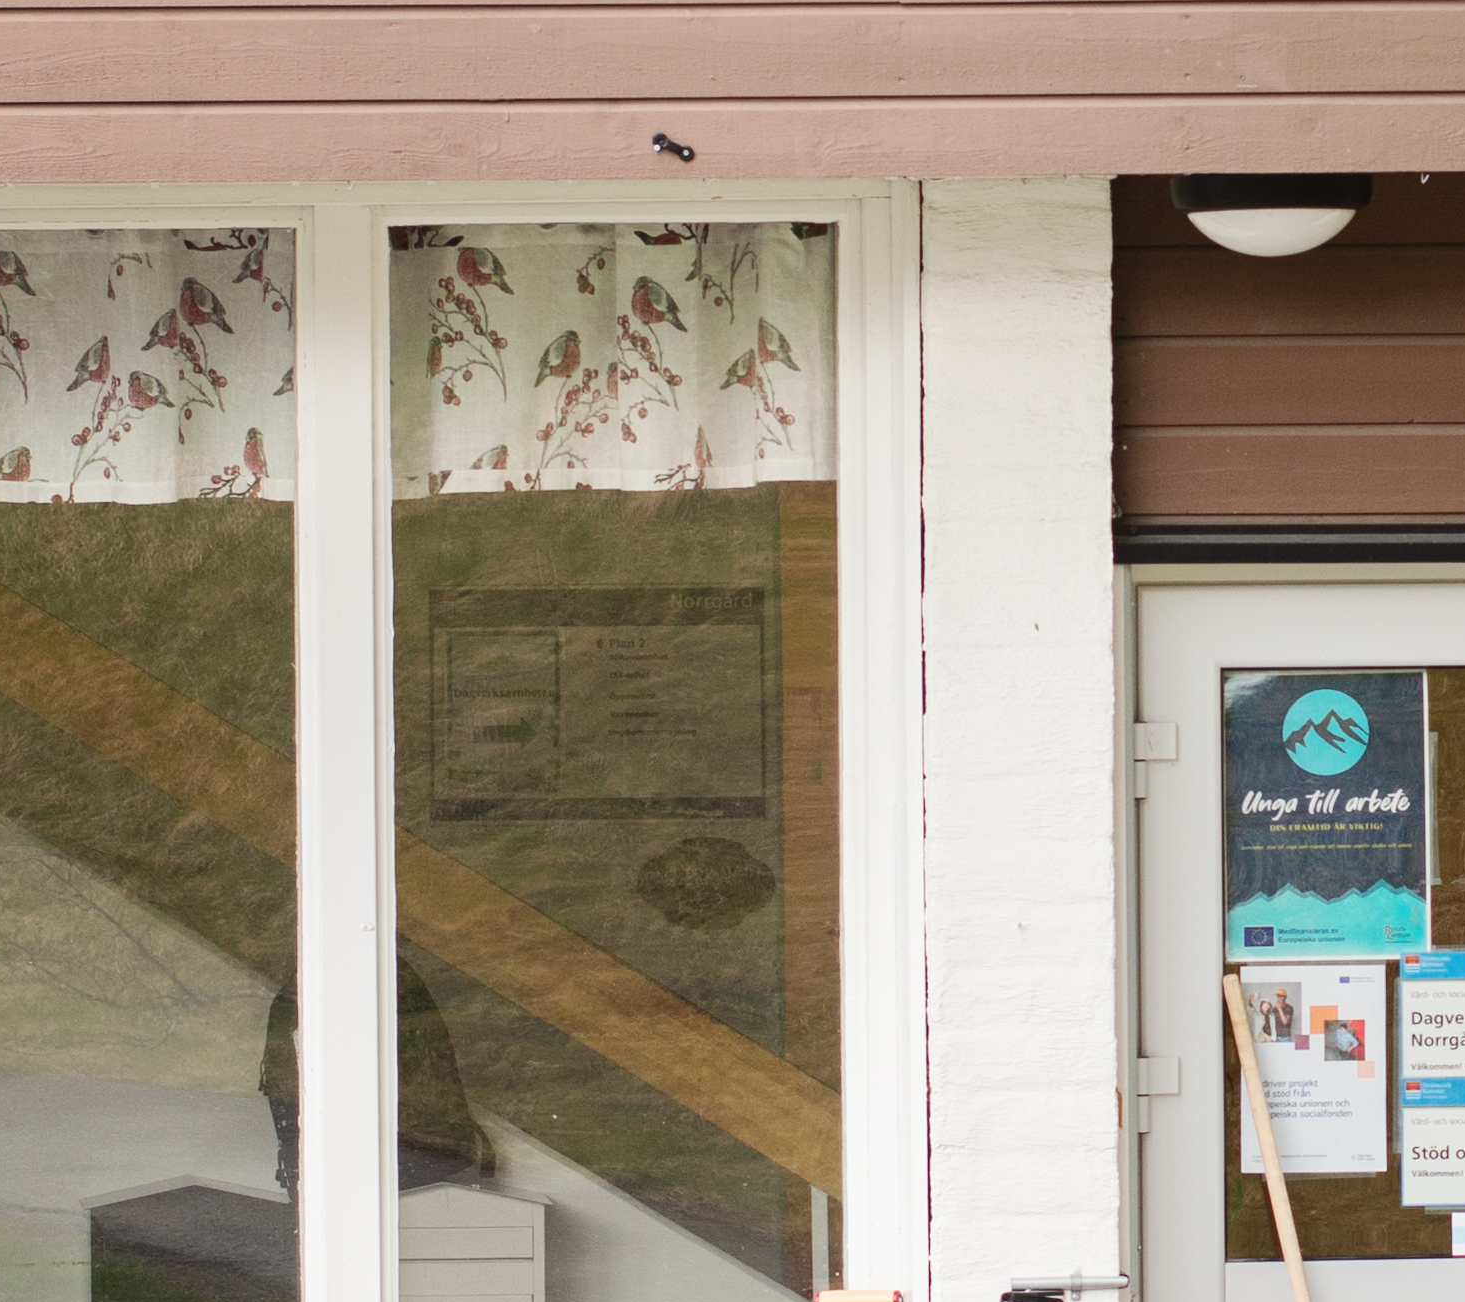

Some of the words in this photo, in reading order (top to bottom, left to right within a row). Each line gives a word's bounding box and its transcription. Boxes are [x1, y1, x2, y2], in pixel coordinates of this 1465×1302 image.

[1241, 790, 1299, 822] Unga
[1305, 788, 1341, 815] till
[1345, 788, 1411, 814] arbete
[1263, 1080, 1286, 1088] driver
[1289, 1080, 1319, 1089] projekt
[1272, 1089, 1291, 1098] stöd
[1293, 1088, 1311, 1098] från
[1300, 1100, 1333, 1108] unionen
[1335, 1099, 1351, 1107] och
[1300, 1110, 1353, 1118] socialfonden
[1412, 1146, 1450, 1160] Stöd
[1411, 1170, 1463, 1178] Välkommen!
